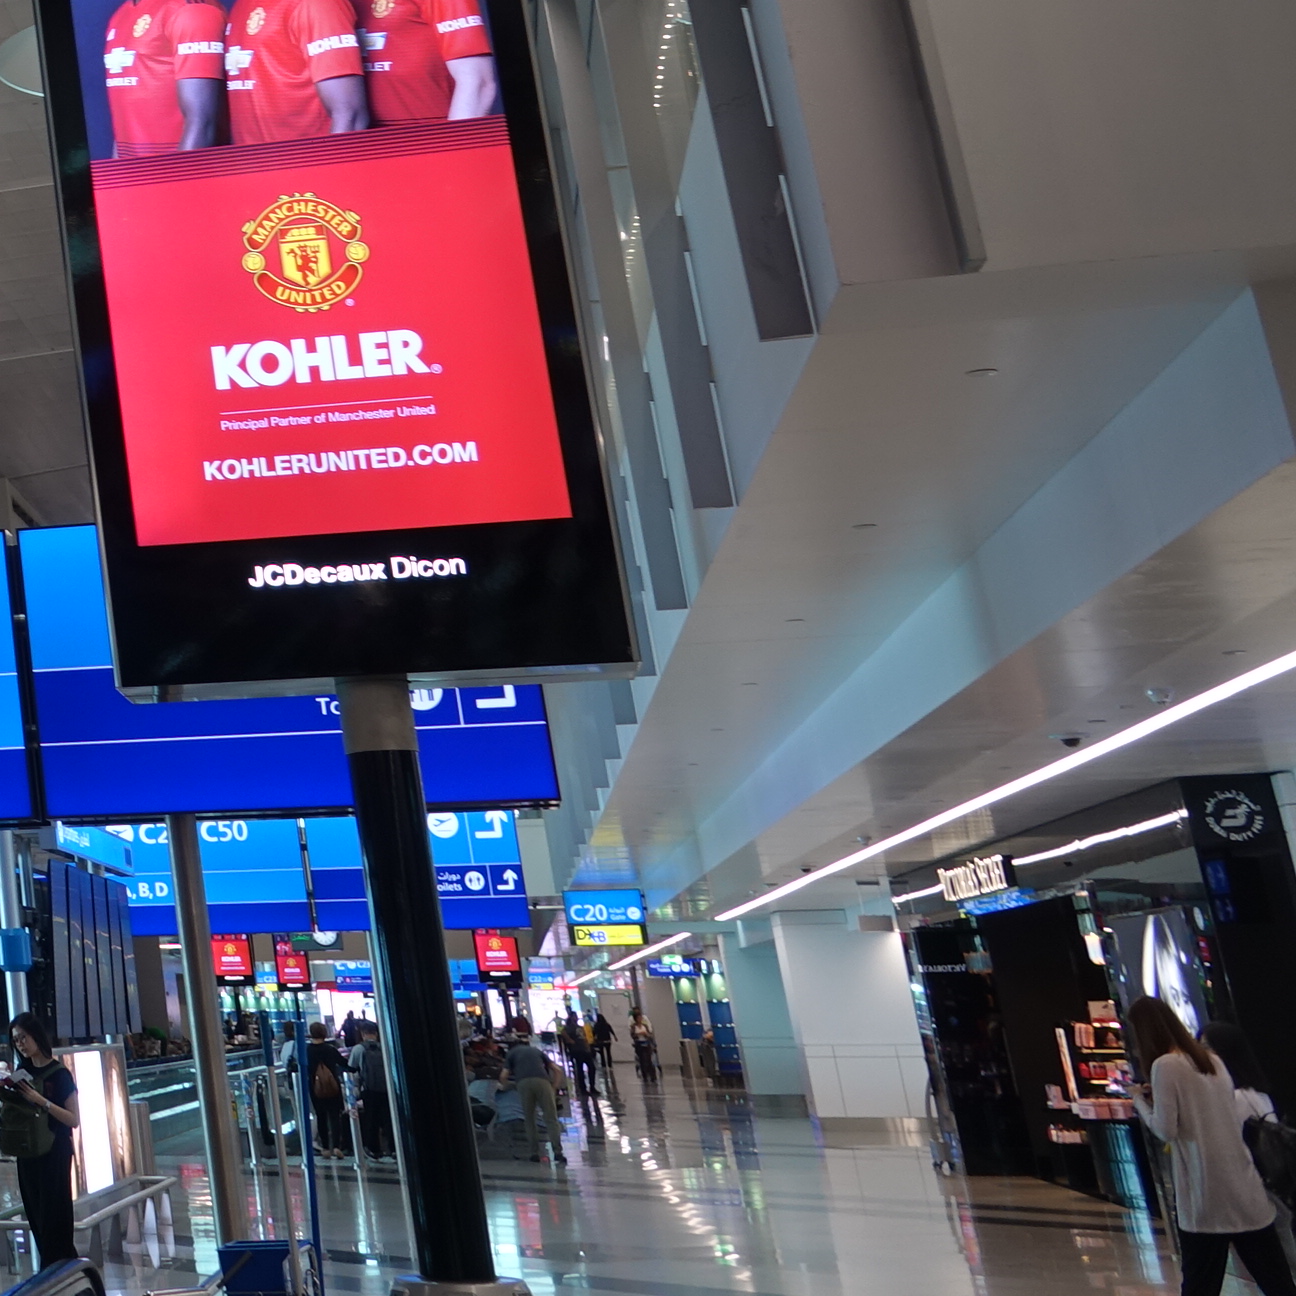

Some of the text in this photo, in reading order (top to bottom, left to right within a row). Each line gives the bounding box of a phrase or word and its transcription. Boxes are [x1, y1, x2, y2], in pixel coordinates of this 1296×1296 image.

[436, 15, 484, 34] KOHLER
[307, 34, 359, 56] KOHLER
[251, 202, 353, 243] MANCHESTER
[275, 281, 347, 305] UNITED
[210, 329, 432, 391] KOHLER
[220, 404, 436, 432] Principal Partner of Manchester United
[203, 441, 479, 481] KOHLERUNITED.COM
[247, 555, 467, 589] JCDecaux Dicon
[201, 820, 248, 842] C50
[570, 904, 608, 921] C20
